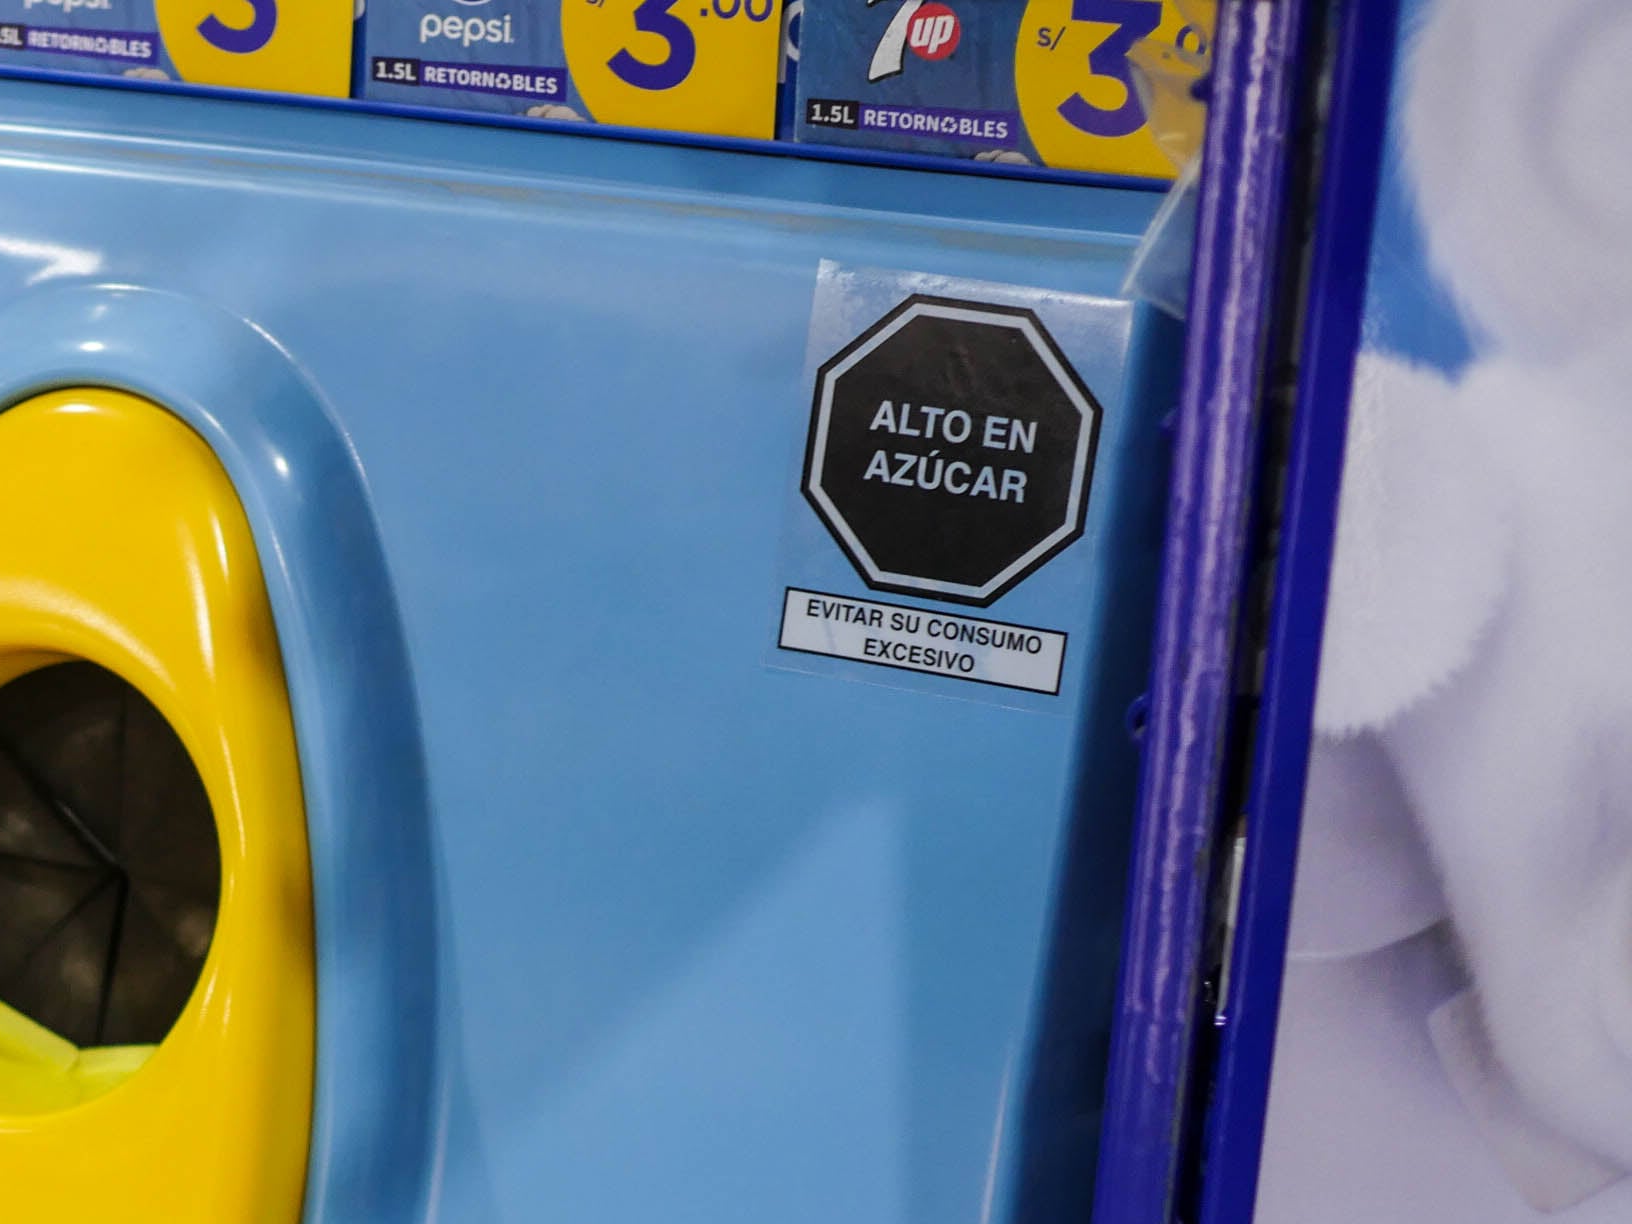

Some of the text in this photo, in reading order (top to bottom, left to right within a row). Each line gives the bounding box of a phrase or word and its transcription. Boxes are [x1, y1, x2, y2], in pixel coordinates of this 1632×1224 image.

[420, 14, 514, 47] pepsi
[1037, 27, 1066, 51] S/
[375, 61, 417, 81] 1.5L
[811, 104, 855, 124] 1.5L
[869, 400, 1038, 453] ALTO EN
[863, 449, 1028, 503] AZÚCAR
[806, 598, 1043, 655] EVITAR SU CONSUMO
[863, 637, 976, 673] EXCESIVO
